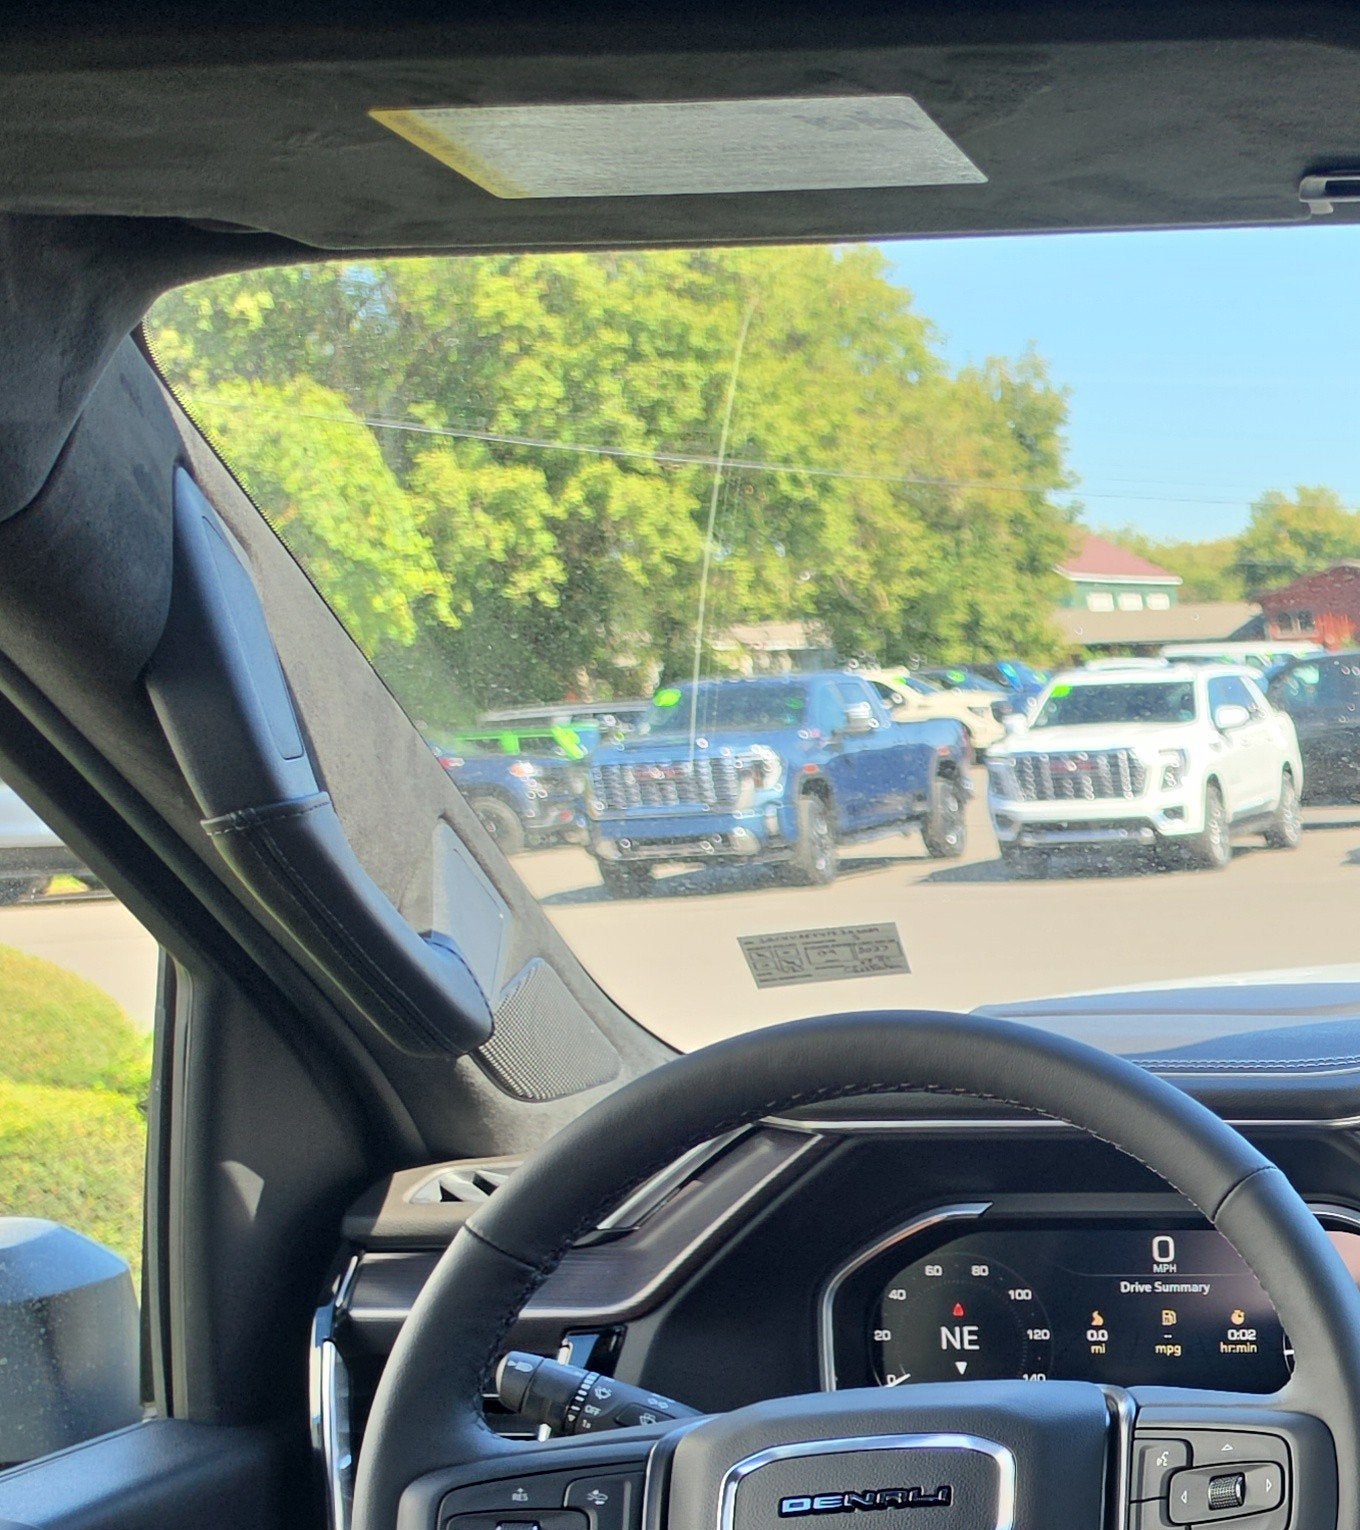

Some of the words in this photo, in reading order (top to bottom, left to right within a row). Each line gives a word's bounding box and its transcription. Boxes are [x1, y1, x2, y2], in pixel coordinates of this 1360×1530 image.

[1152, 1236, 1175, 1263] 0
[925, 1265, 943, 1276] 60
[971, 1265, 989, 1276] 80
[1153, 1263, 1177, 1274] MPH
[1120, 1282, 1152, 1294] Drive
[1154, 1282, 1210, 1296] Summary
[888, 1290, 906, 1301] 40
[1008, 1290, 1032, 1301] 100
[873, 1330, 891, 1341] 20
[940, 1326, 980, 1351] NE
[1026, 1330, 1050, 1341] 120
[1086, 1330, 1108, 1341] 0.0
[1227, 1330, 1256, 1341] 0:02
[1091, 1342, 1106, 1354] mi
[1155, 1343, 1181, 1357] mpg
[1220, 1342, 1257, 1354] hr:min
[512, 1491, 529, 1503] RES
[781, 1487, 952, 1514] DENALI
